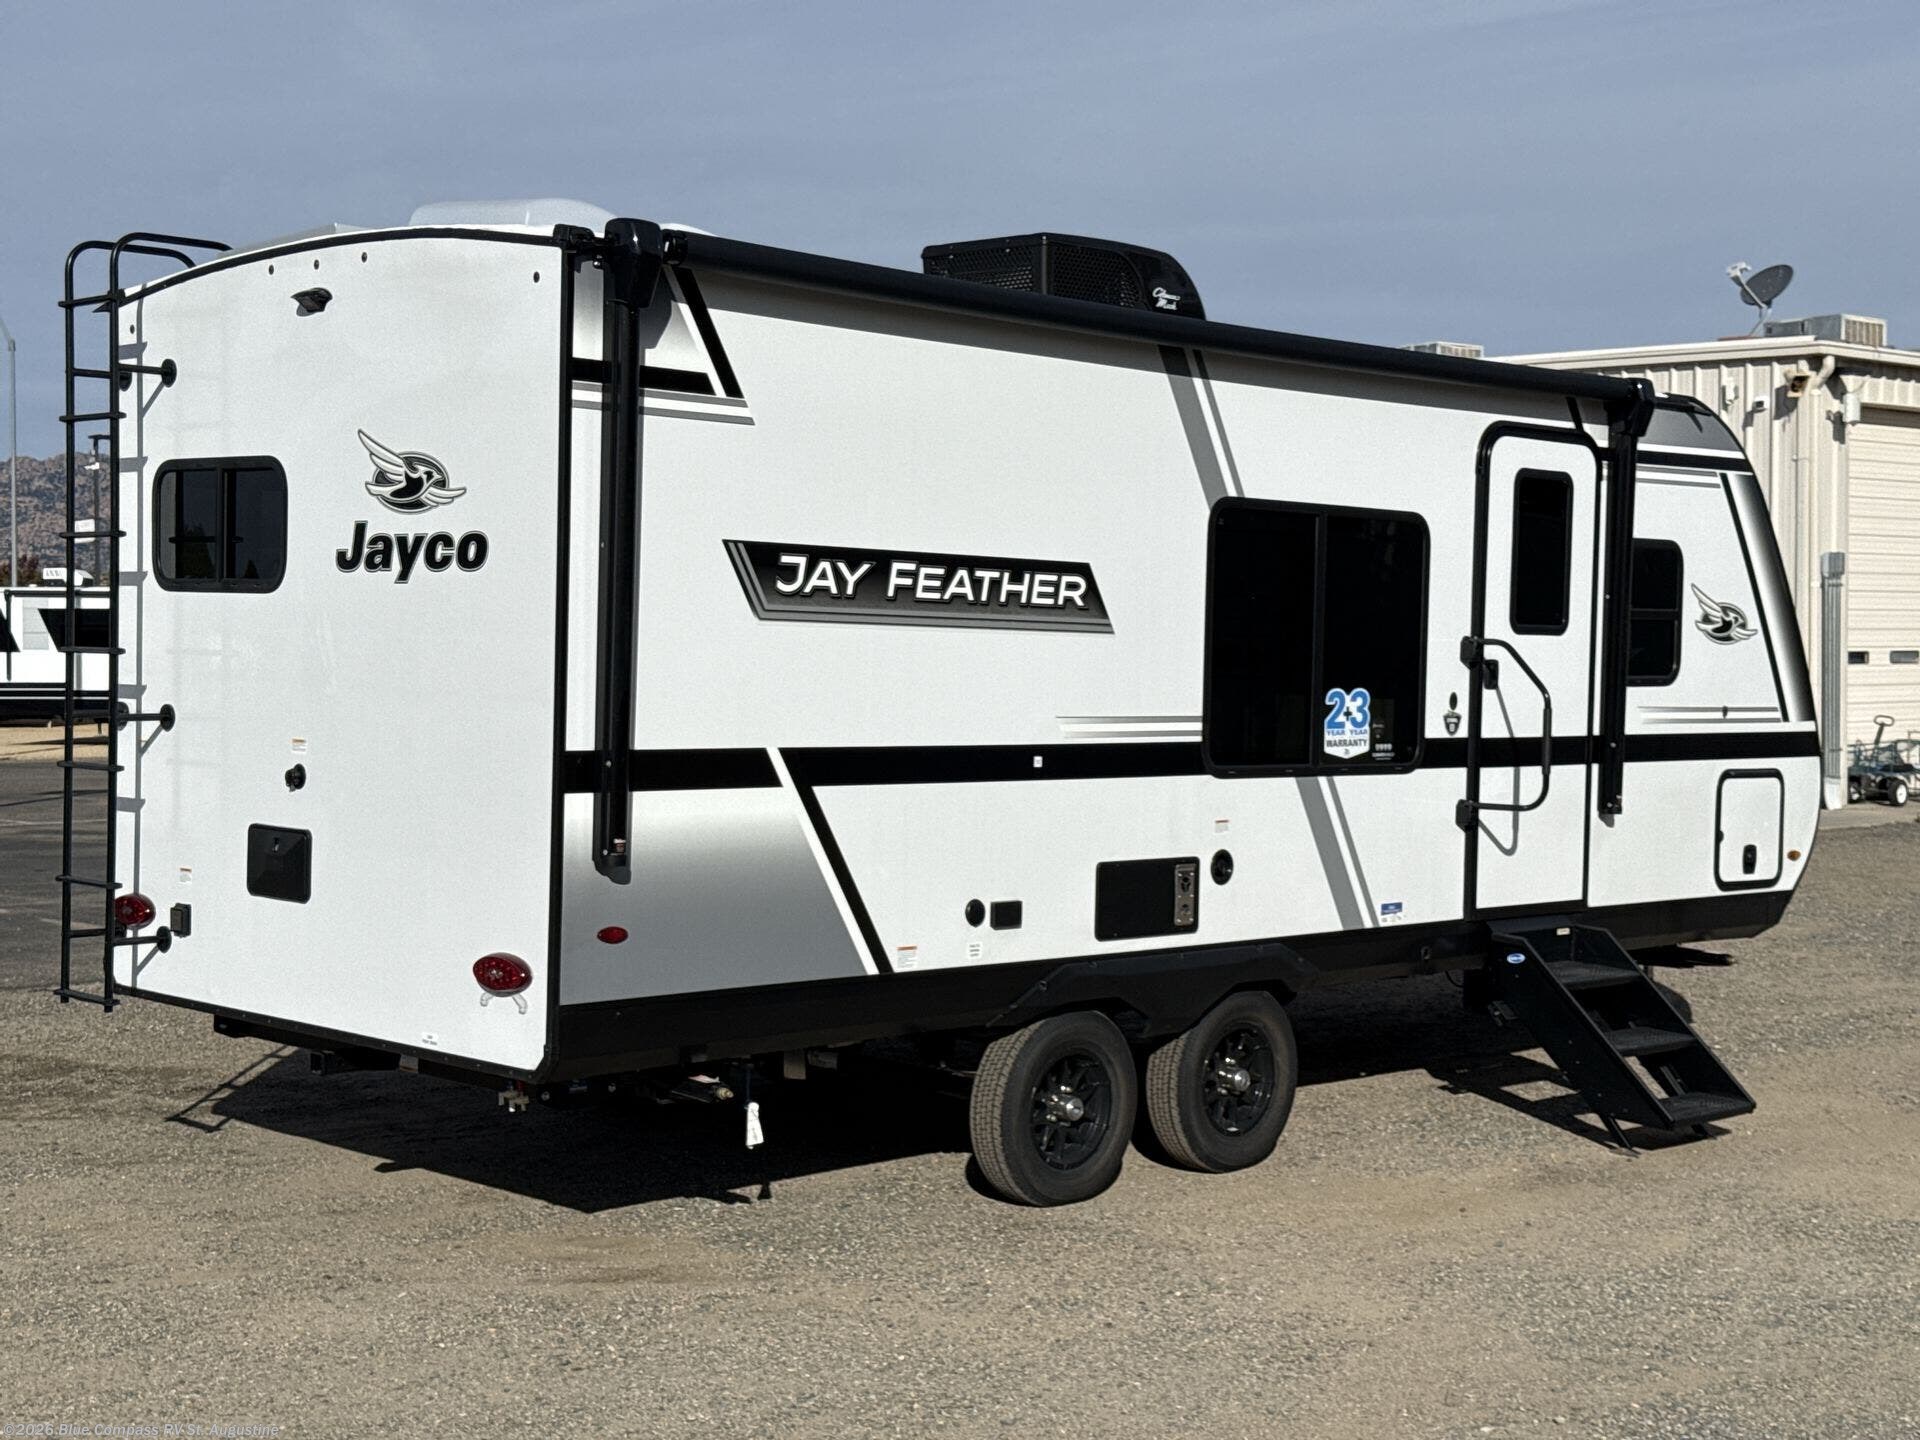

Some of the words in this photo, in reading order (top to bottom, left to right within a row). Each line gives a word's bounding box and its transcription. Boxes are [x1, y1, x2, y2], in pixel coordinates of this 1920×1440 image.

[335, 520, 489, 584] Jayco
[775, 553, 875, 597] JAY
[886, 559, 1090, 608] FEATHER
[1326, 738, 1368, 748] WARRANTY
[1327, 729, 1346, 737] YEAR
[1349, 728, 1368, 737] YEAR
